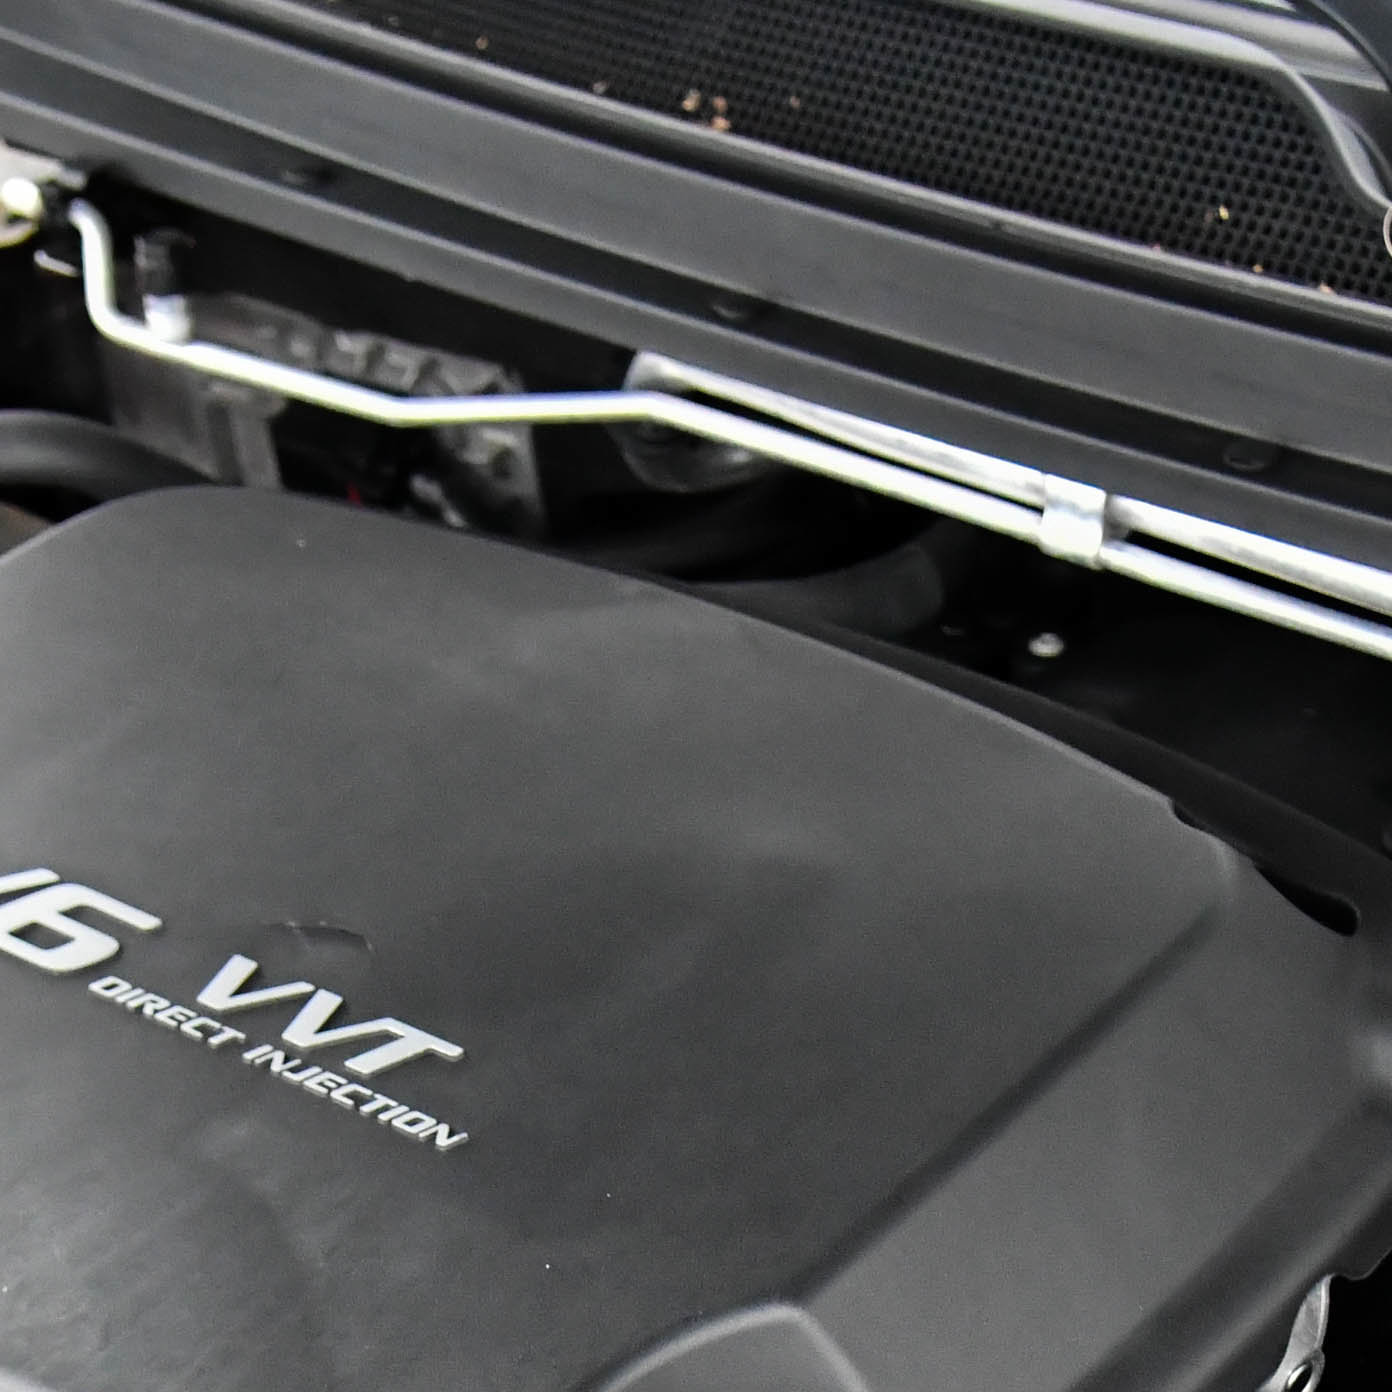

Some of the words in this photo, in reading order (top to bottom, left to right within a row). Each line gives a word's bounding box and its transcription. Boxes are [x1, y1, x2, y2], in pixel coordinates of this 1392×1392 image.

[88, 975, 246, 1049] DIRECT
[242, 1043, 469, 1150] INJECTION
[198, 954, 465, 1076] VVT
